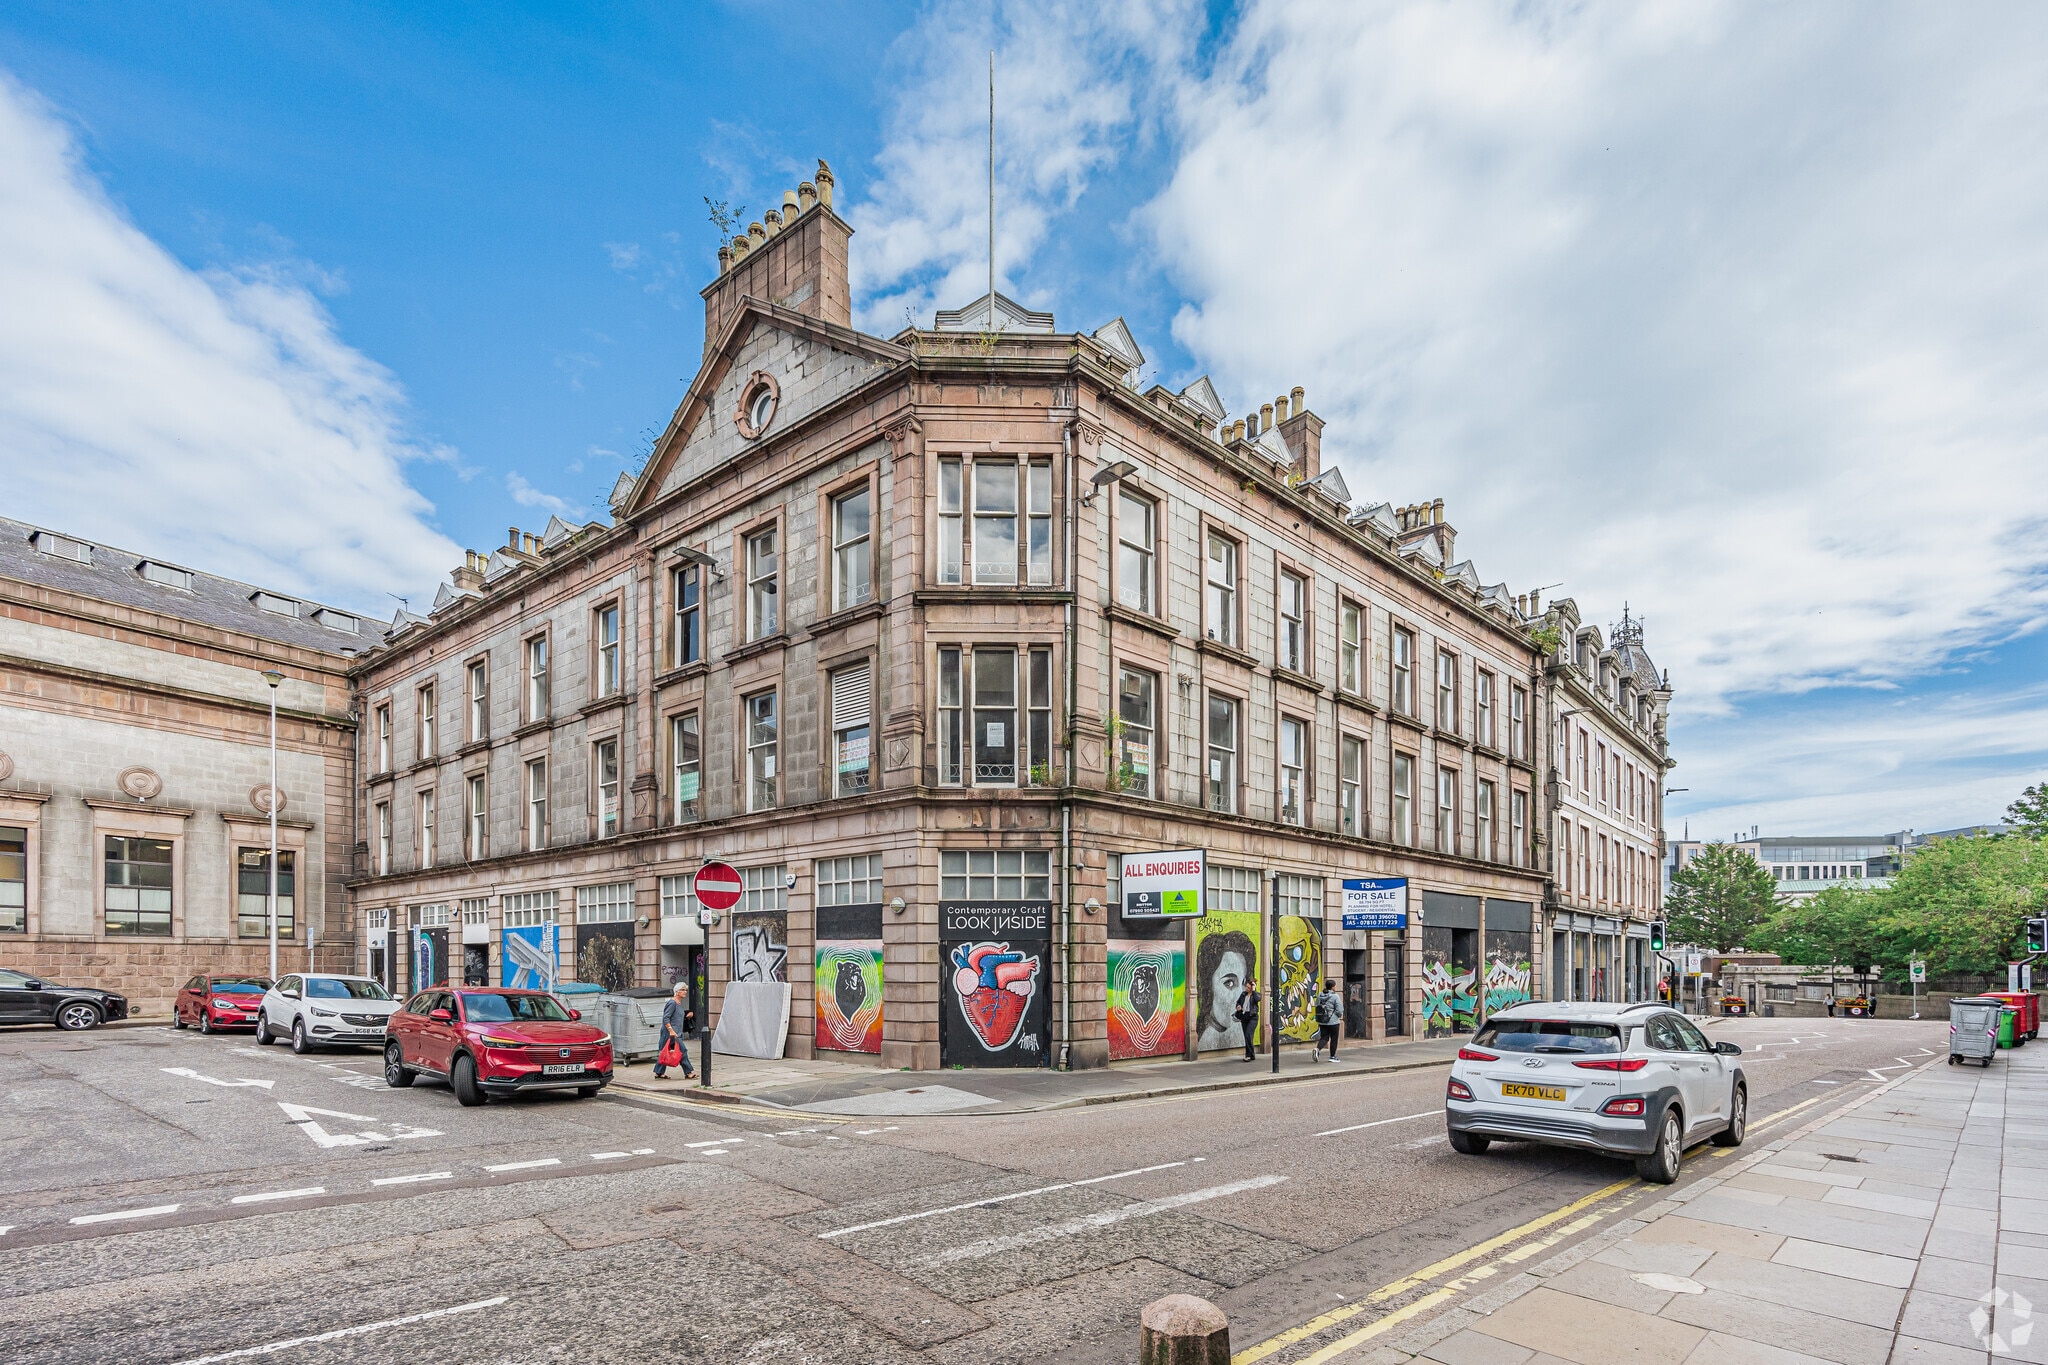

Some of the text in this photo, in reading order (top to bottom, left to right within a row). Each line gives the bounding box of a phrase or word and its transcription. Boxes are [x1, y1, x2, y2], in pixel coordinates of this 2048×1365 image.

[1125, 861, 1200, 877] ALL ENQUIRIES
[1348, 892, 1396, 900] FOR SALE
[947, 906, 1046, 915] Contemporary Craft
[947, 916, 991, 929] LOOK
[548, 1065, 565, 1073] RR16
[1506, 1085, 1560, 1099] EK70 VLC
